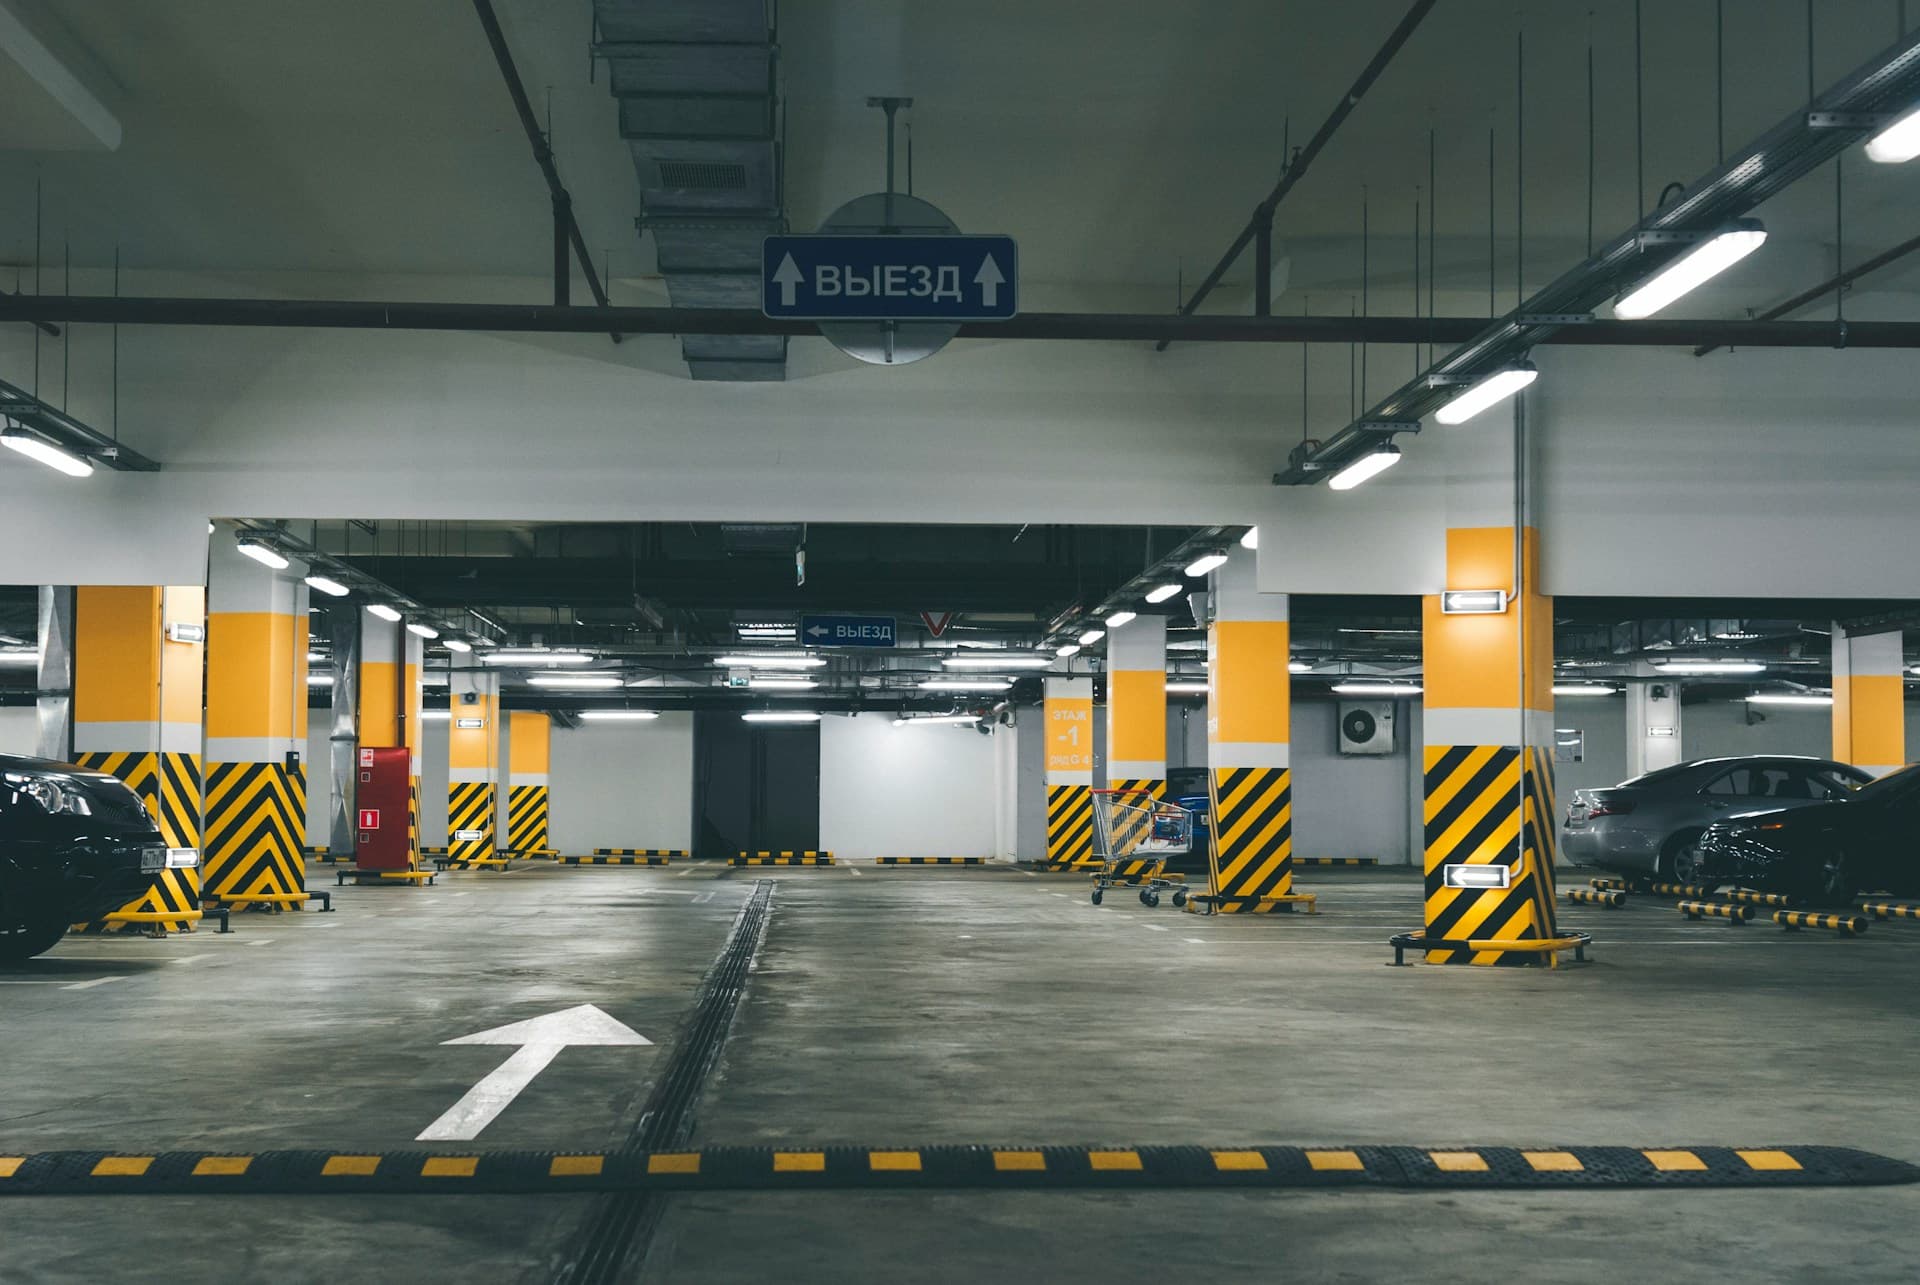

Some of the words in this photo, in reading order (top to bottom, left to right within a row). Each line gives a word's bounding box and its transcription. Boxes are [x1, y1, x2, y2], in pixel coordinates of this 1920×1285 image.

[815, 265, 962, 303] ВЫЕЗД
[836, 625, 891, 640] ВЫЕЗД
[1053, 710, 1087, 721] ЭТАЖ
[1058, 725, 1078, 746] -1
